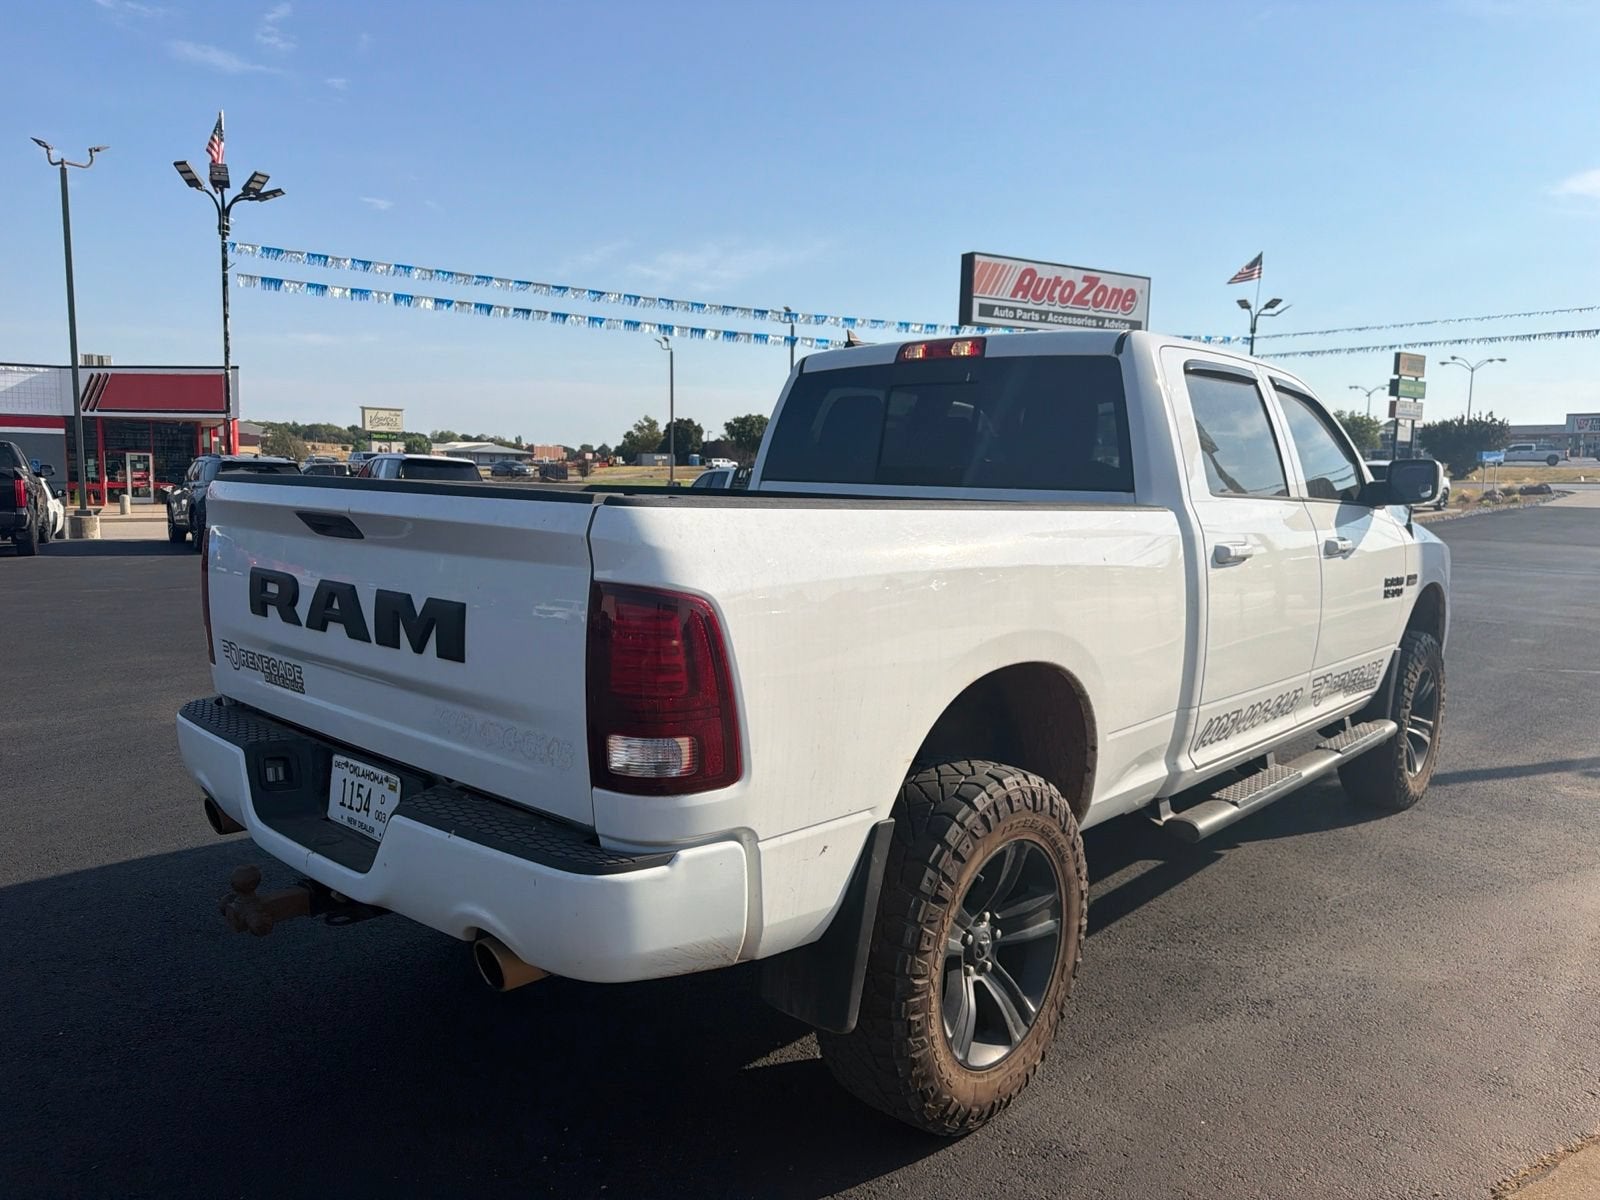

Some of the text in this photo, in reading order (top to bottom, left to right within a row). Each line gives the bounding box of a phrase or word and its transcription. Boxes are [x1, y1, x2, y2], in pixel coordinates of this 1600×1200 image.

[1009, 267, 1137, 314] AutoZone
[993, 306, 1131, 330] Auto Parts Accessories Advice
[249, 566, 467, 664] RAM
[239, 647, 304, 684] RENEGADE
[335, 760, 345, 769] DEC
[349, 764, 384, 786] OKLAHOMA
[339, 777, 372, 818] 1154
[380, 794, 386, 805] D
[347, 815, 375, 833] NEW DEALER
